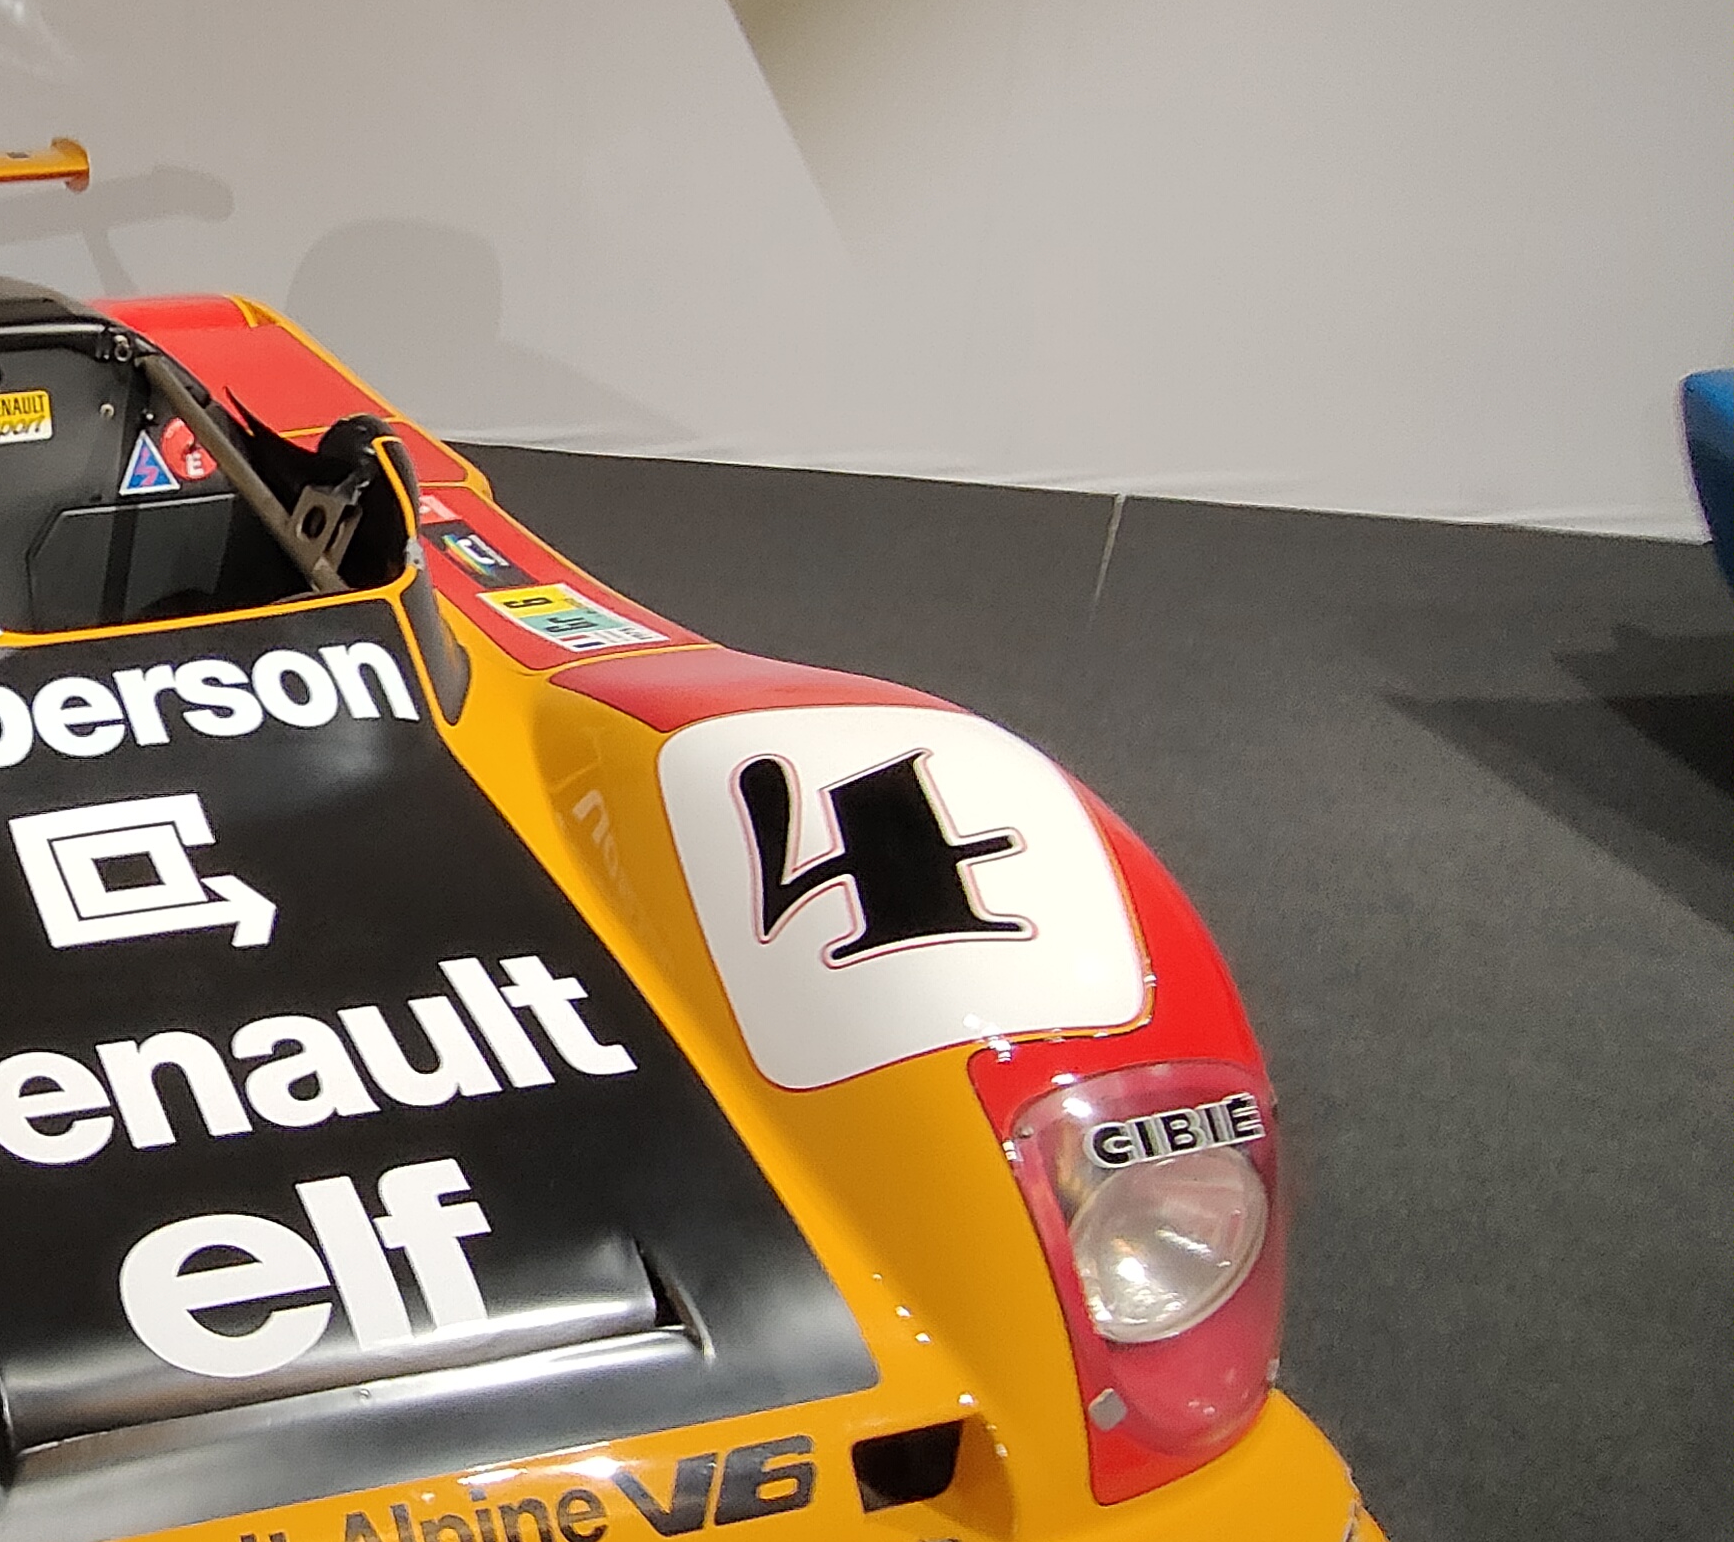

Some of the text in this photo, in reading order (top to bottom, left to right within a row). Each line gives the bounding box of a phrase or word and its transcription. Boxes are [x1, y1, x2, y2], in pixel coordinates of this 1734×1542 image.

[732, 747, 1038, 965] 4
[119, 1157, 493, 1379] elf
[610, 1434, 816, 1538] V6
